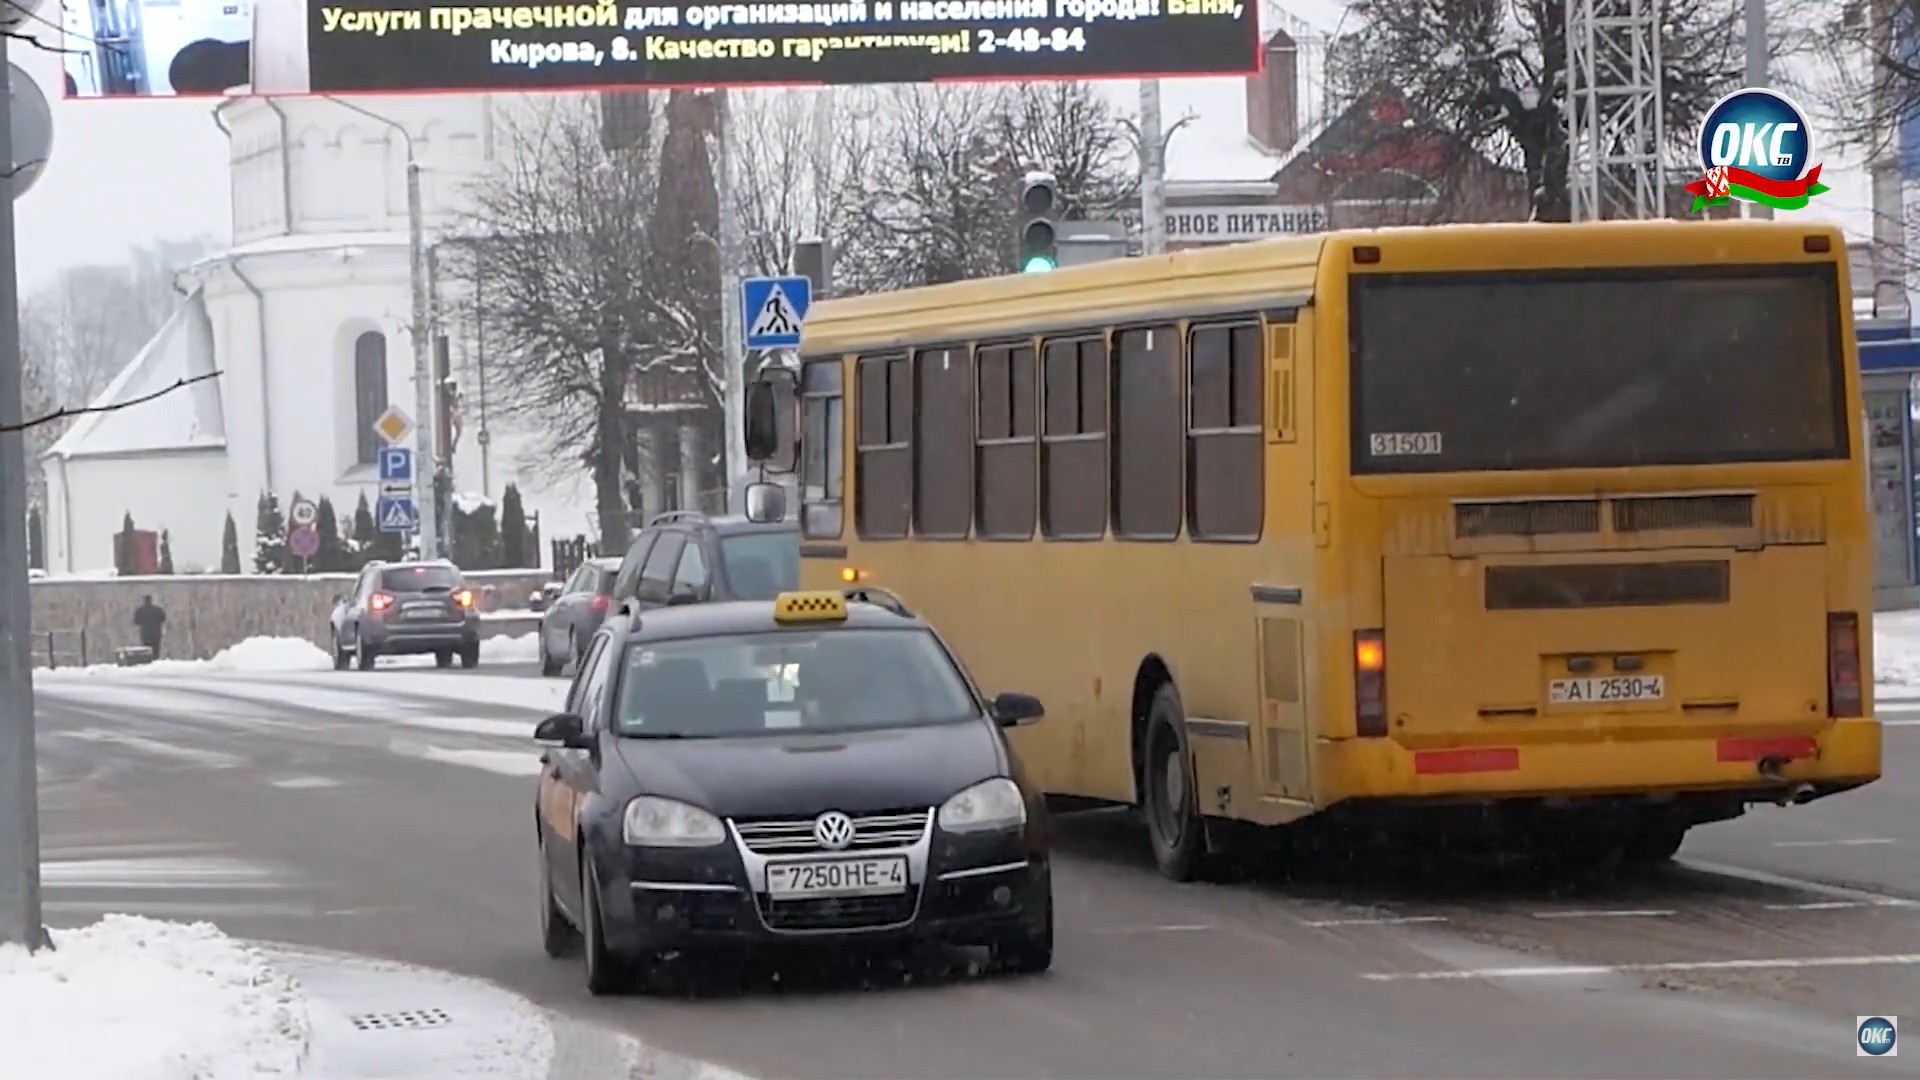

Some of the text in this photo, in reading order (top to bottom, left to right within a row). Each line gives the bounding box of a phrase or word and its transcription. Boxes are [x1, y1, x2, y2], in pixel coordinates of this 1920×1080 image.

[322, 0, 1243, 36] Услуги прачечной для организаций и населения города! Баня,
[491, 38, 604, 68] Кирова,
[611, 36, 637, 61] 8.
[645, 36, 775, 61] Качество
[977, 27, 1085, 53] 2-48-84
[1227, 211, 1323, 233] ПИТАНИЕ
[1373, 434, 1438, 453] 31501
[387, 452, 406, 477] P
[1600, 677, 1660, 699] 2530-4
